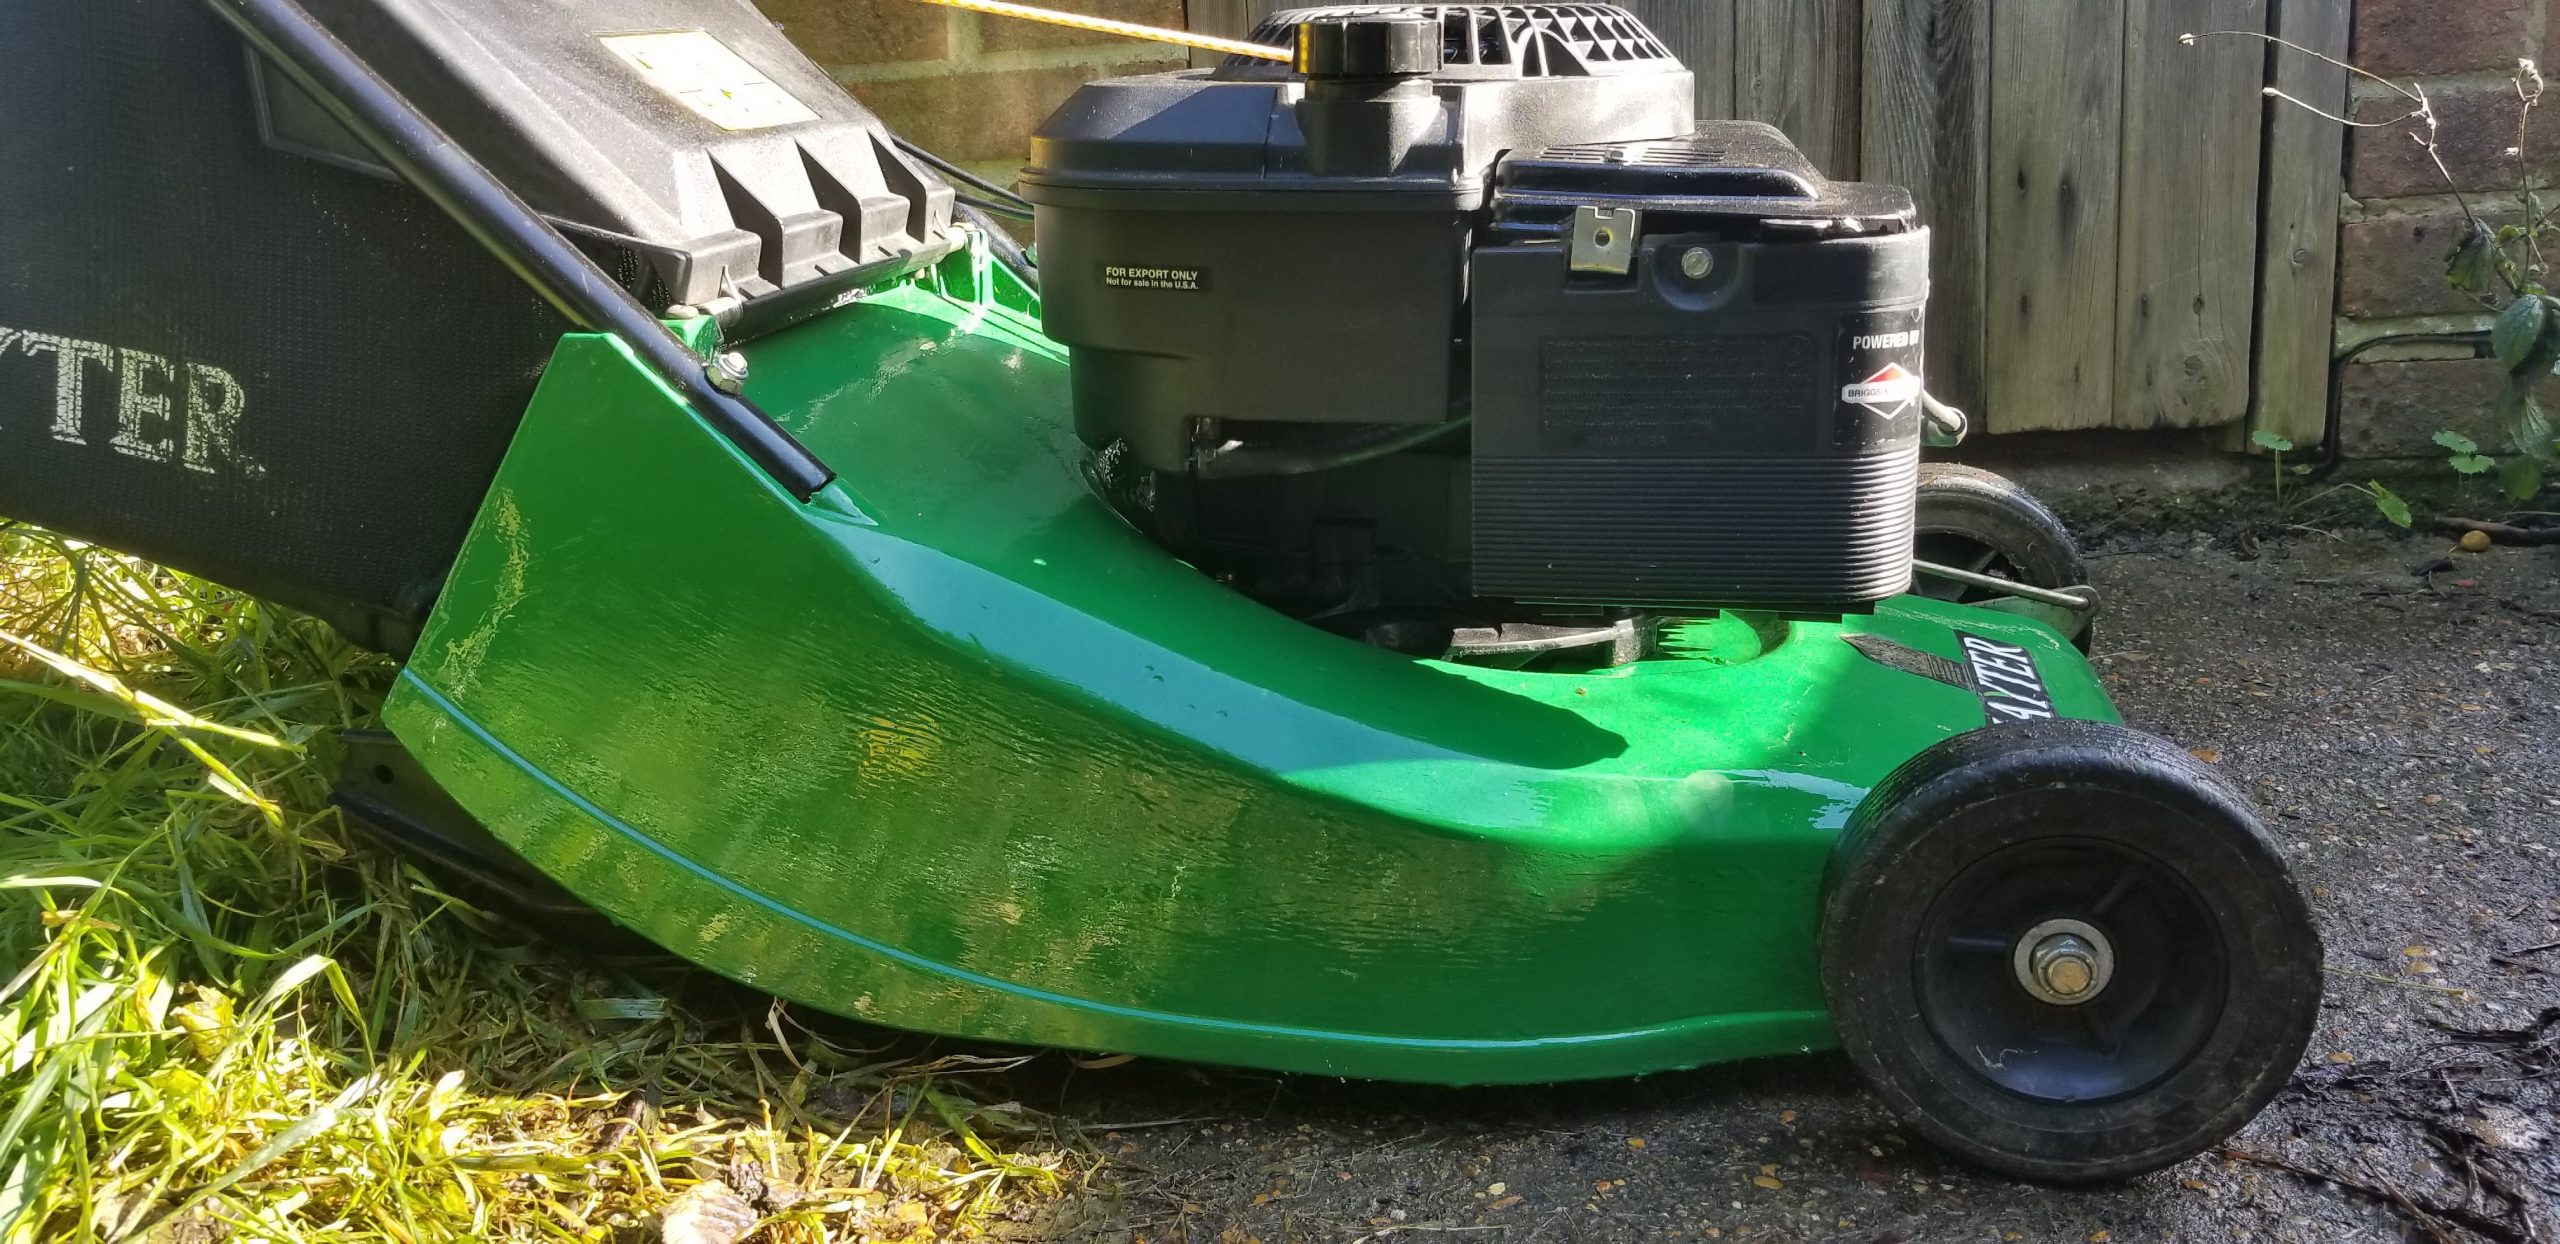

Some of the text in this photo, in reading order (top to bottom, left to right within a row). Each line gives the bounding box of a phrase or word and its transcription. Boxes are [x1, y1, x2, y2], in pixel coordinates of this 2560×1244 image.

[1106, 266, 1198, 281] FOR EXPORT ONLY
[1106, 277, 1199, 290] Not for sale in the U.S.A.
[1852, 331, 1909, 350] POWERED
[1847, 388, 1882, 398] BRIGGS
[1963, 637, 2053, 724] AYTER
